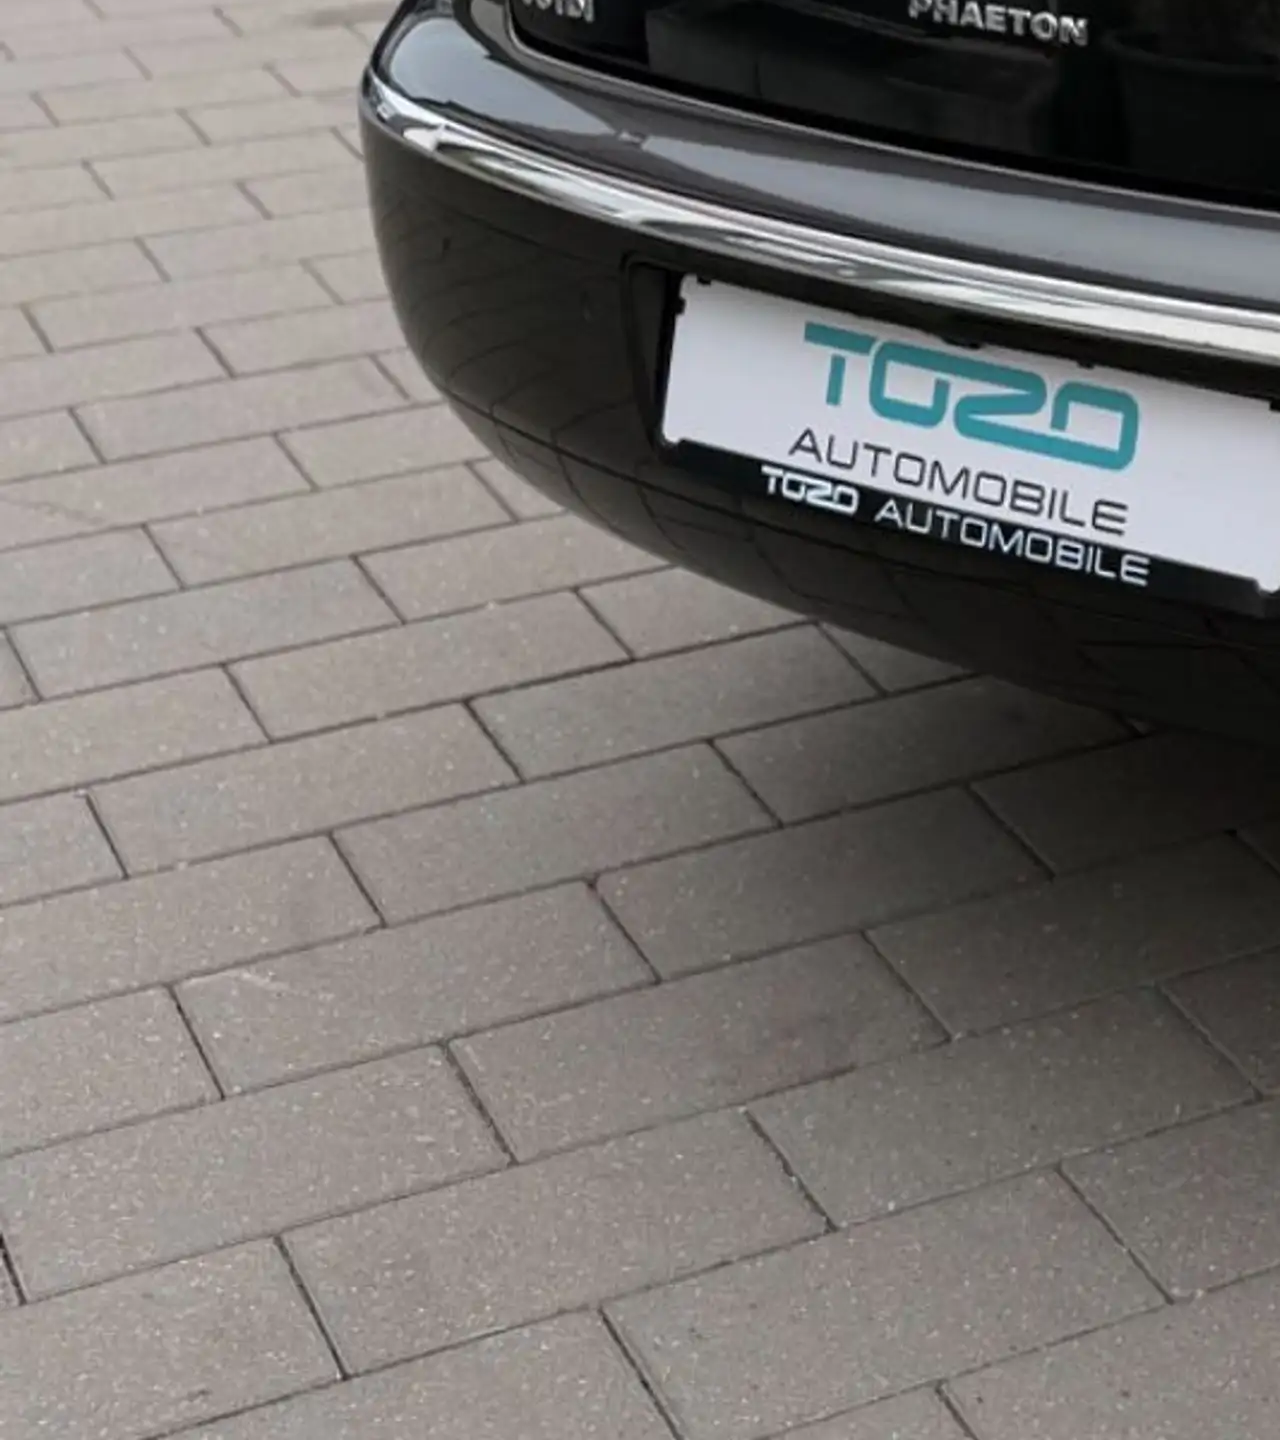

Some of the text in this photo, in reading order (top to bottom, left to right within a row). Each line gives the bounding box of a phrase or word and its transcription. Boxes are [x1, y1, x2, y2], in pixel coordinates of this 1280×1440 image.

[804, 321, 1139, 471] TOZO
[760, 465, 1151, 587] TOZO AUTOMOBILE
[789, 428, 1128, 536] AUTOMOBILE
